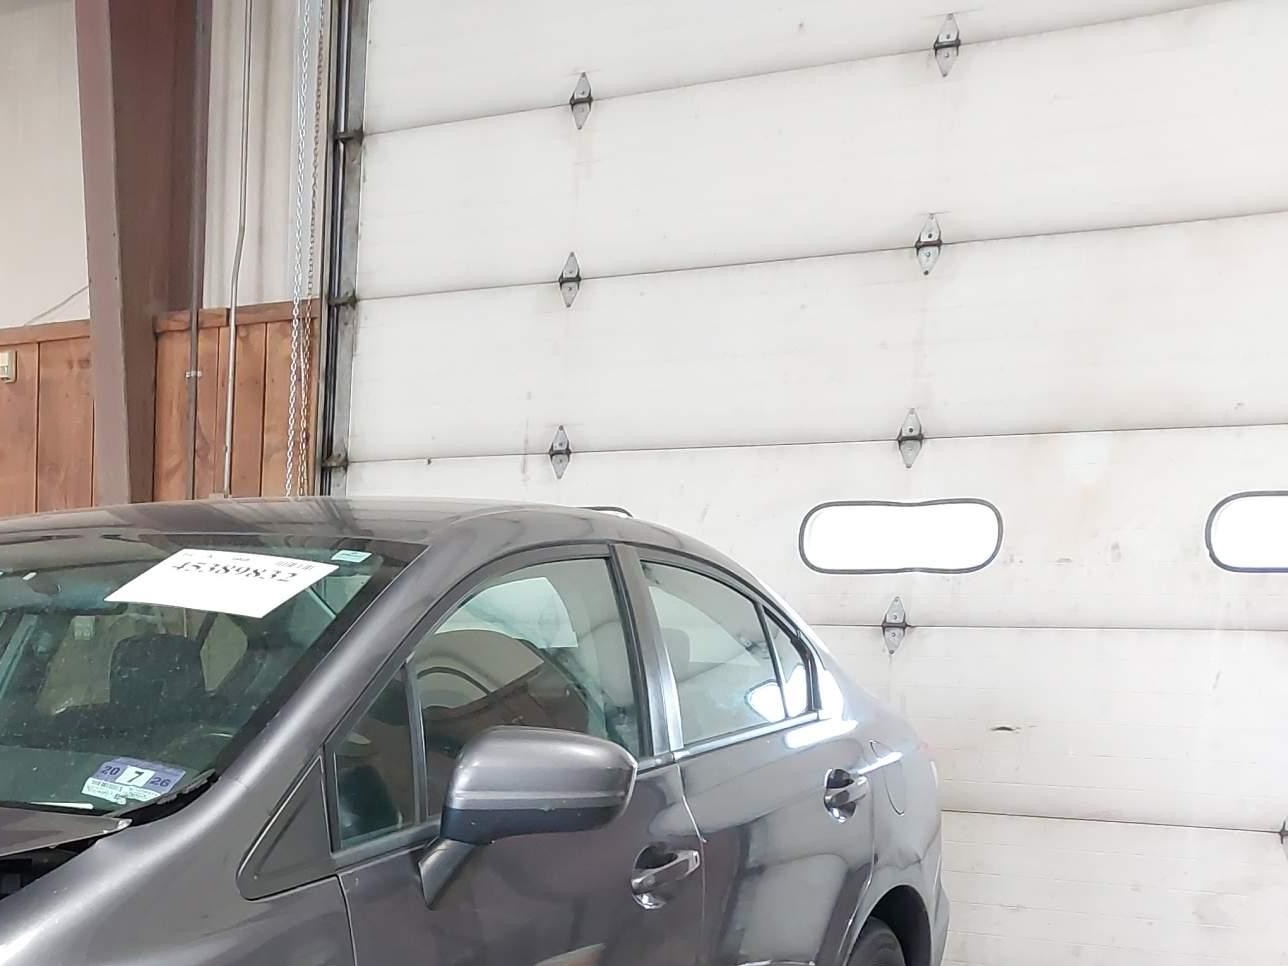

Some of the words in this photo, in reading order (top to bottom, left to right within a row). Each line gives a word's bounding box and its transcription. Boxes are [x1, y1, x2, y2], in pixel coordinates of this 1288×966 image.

[101, 765, 120, 775] 20
[127, 771, 144, 783] 7
[150, 776, 171, 787] 26
